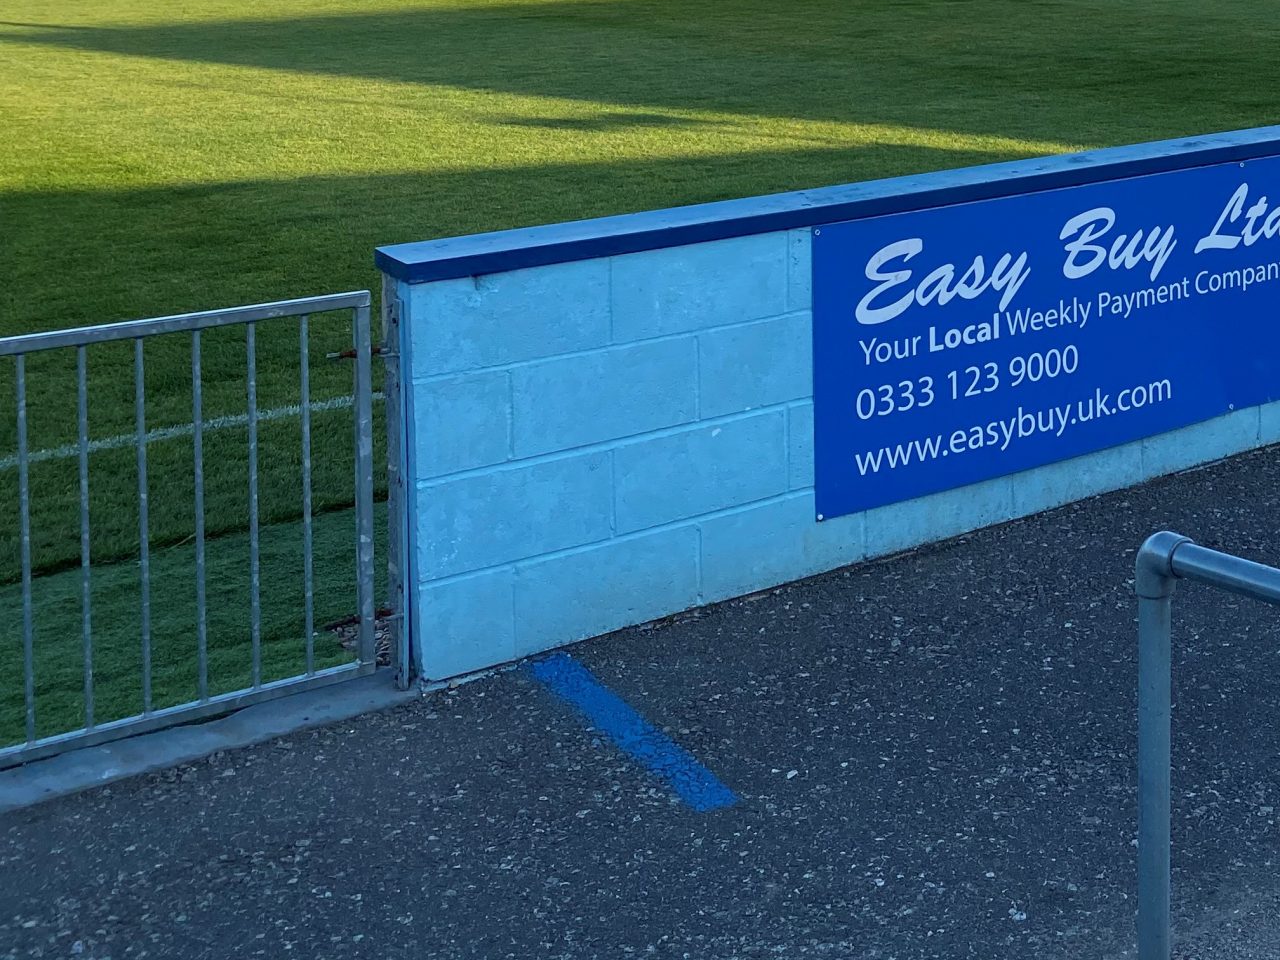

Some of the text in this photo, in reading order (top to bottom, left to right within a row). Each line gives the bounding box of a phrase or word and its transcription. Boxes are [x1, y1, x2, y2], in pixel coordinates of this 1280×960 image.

[855, 238, 1031, 325] Easy
[1059, 207, 1177, 282] Buy
[859, 335, 922, 366] Your
[928, 313, 1001, 354] Local
[1006, 298, 1092, 337] Weekly
[1098, 276, 1190, 320] Payment
[855, 376, 1173, 477] www.easybuy.uk.com
[856, 344, 1079, 421] 0333 123 9000
